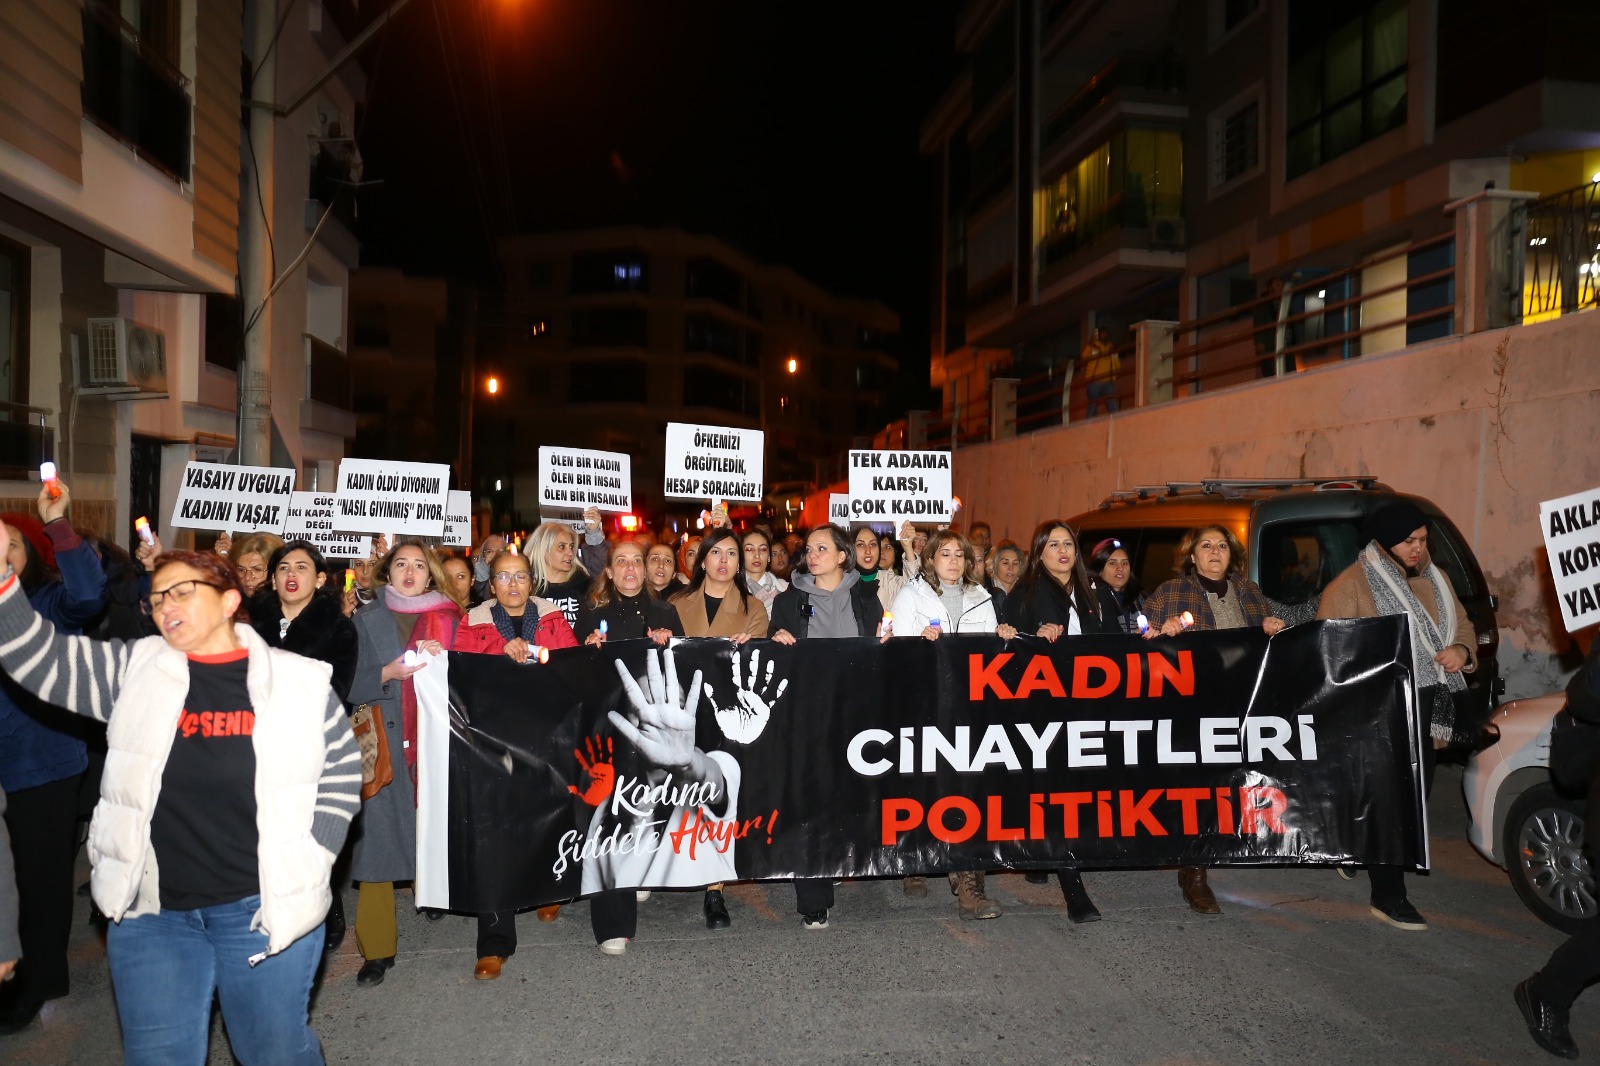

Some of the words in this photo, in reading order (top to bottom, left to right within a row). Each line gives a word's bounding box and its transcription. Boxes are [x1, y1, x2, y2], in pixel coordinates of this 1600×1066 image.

[694, 428, 740, 450] ÖFKEMİZİ
[551, 452, 574, 467] ÖLEN
[576, 454, 591, 468] BİR
[594, 458, 620, 472] KADIN
[684, 451, 746, 476] ÖRGÜTLEDİK,
[851, 453, 882, 467] TEK
[887, 454, 949, 469] ADAMA
[186, 468, 235, 490] YASAYI
[237, 473, 291, 494] UYGULA
[347, 473, 374, 490] KADIN
[376, 470, 399, 491] ÖLDÜ
[401, 472, 439, 494] DİYORUM
[551, 469, 574, 484] ÖLEN
[576, 472, 592, 486] BİR
[594, 472, 621, 489] İNSAN
[666, 478, 699, 494] HESAP
[702, 478, 756, 498] SORACAĞIZ
[873, 476, 928, 495] KARŞI,
[314, 496, 333, 508] GÜÇ
[544, 486, 568, 500] ÖLEN
[570, 488, 585, 502] BİR
[588, 489, 628, 506] İNSANLIK
[180, 499, 233, 521] KADINI
[236, 503, 279, 529] YAŞAT.
[417, 501, 444, 520] DİYOR.
[852, 499, 886, 518] ÇOK
[892, 500, 949, 514] KADIN.
[315, 532, 361, 542] EĞMEYEN
[330, 544, 360, 554] GELİR.
[1558, 541, 1600, 578] KOR
[969, 650, 1194, 701] KADIN
[611, 773, 720, 817] Kadına
[881, 786, 1288, 846] POLİTİKTİR
[552, 819, 667, 881] Şiddete
